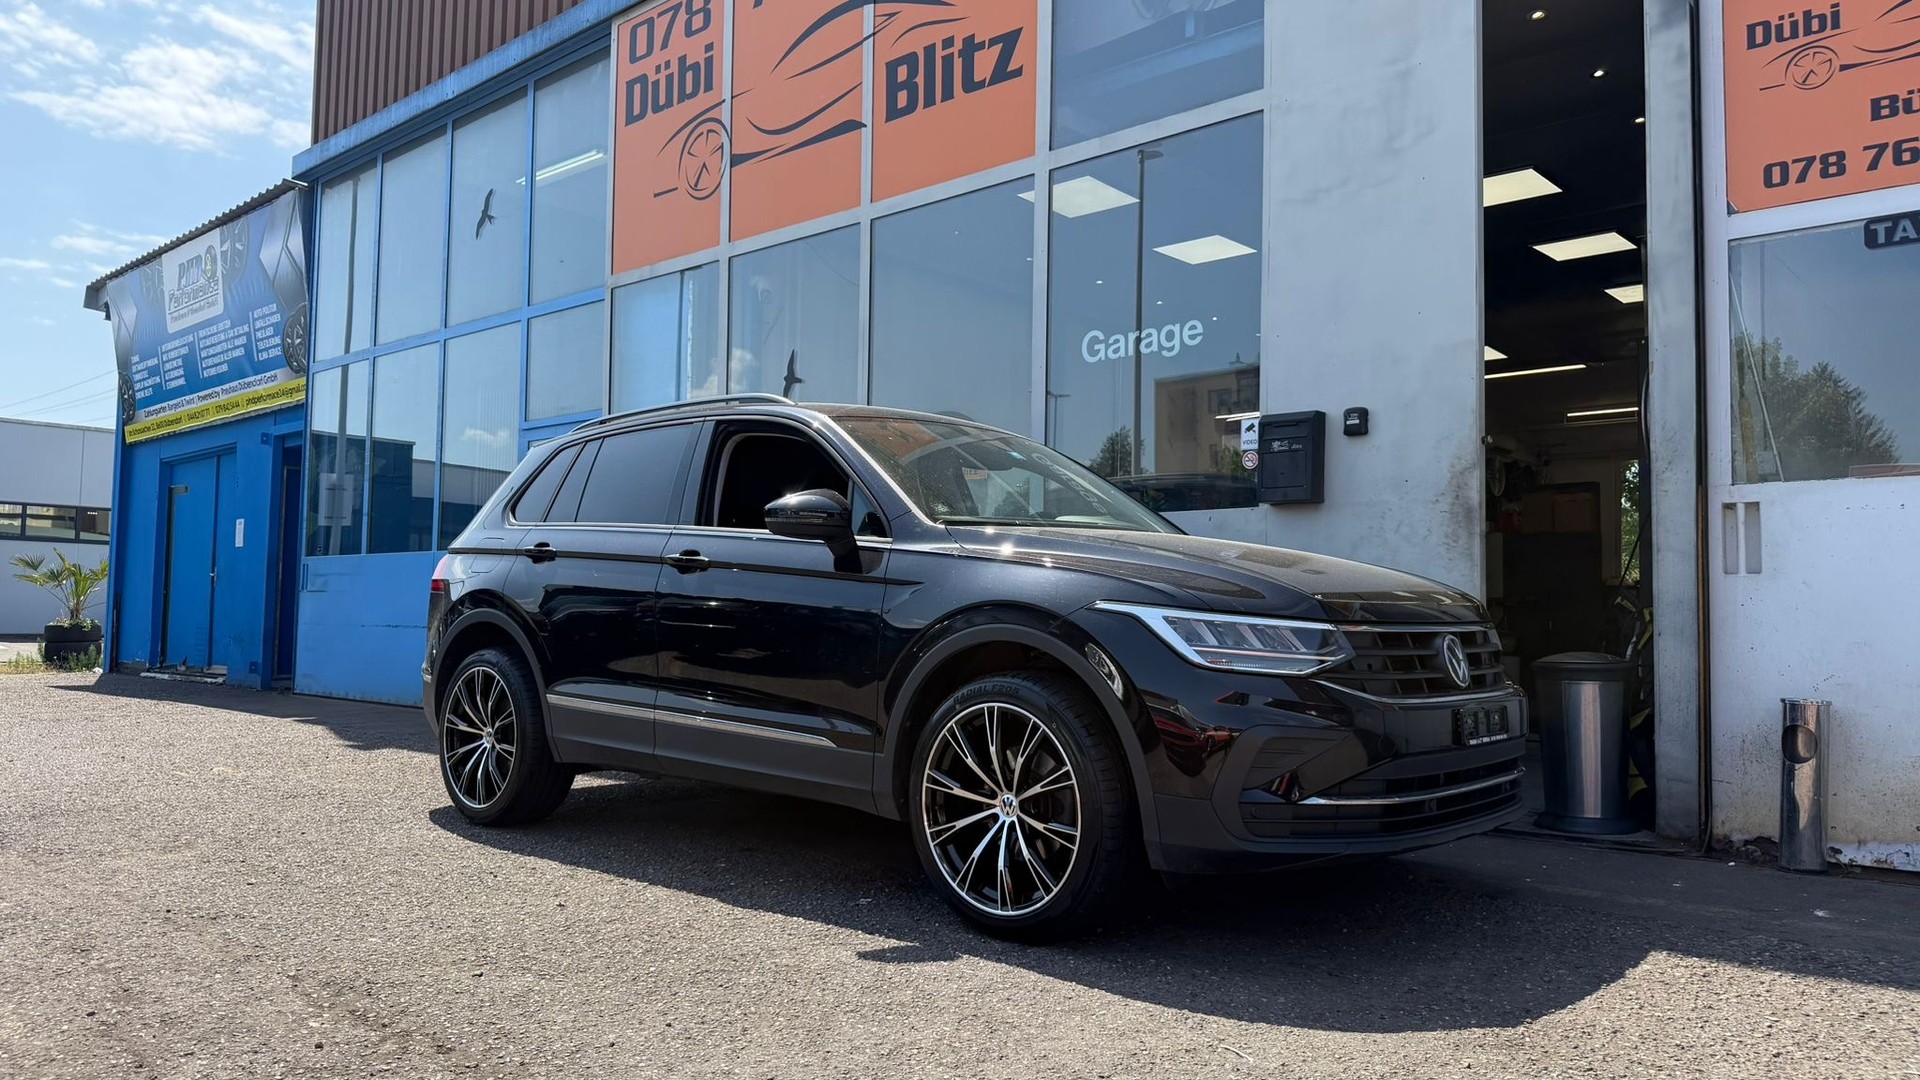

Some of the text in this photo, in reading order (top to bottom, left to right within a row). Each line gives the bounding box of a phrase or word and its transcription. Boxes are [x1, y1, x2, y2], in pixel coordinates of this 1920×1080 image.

[629, 0, 712, 65] 078
[1746, 2, 1841, 50] Dübi
[625, 41, 714, 127] Dübi
[885, 26, 1025, 124] Blitz
[1763, 137, 1920, 189] 078 76
[1081, 319, 1204, 364] Garage
